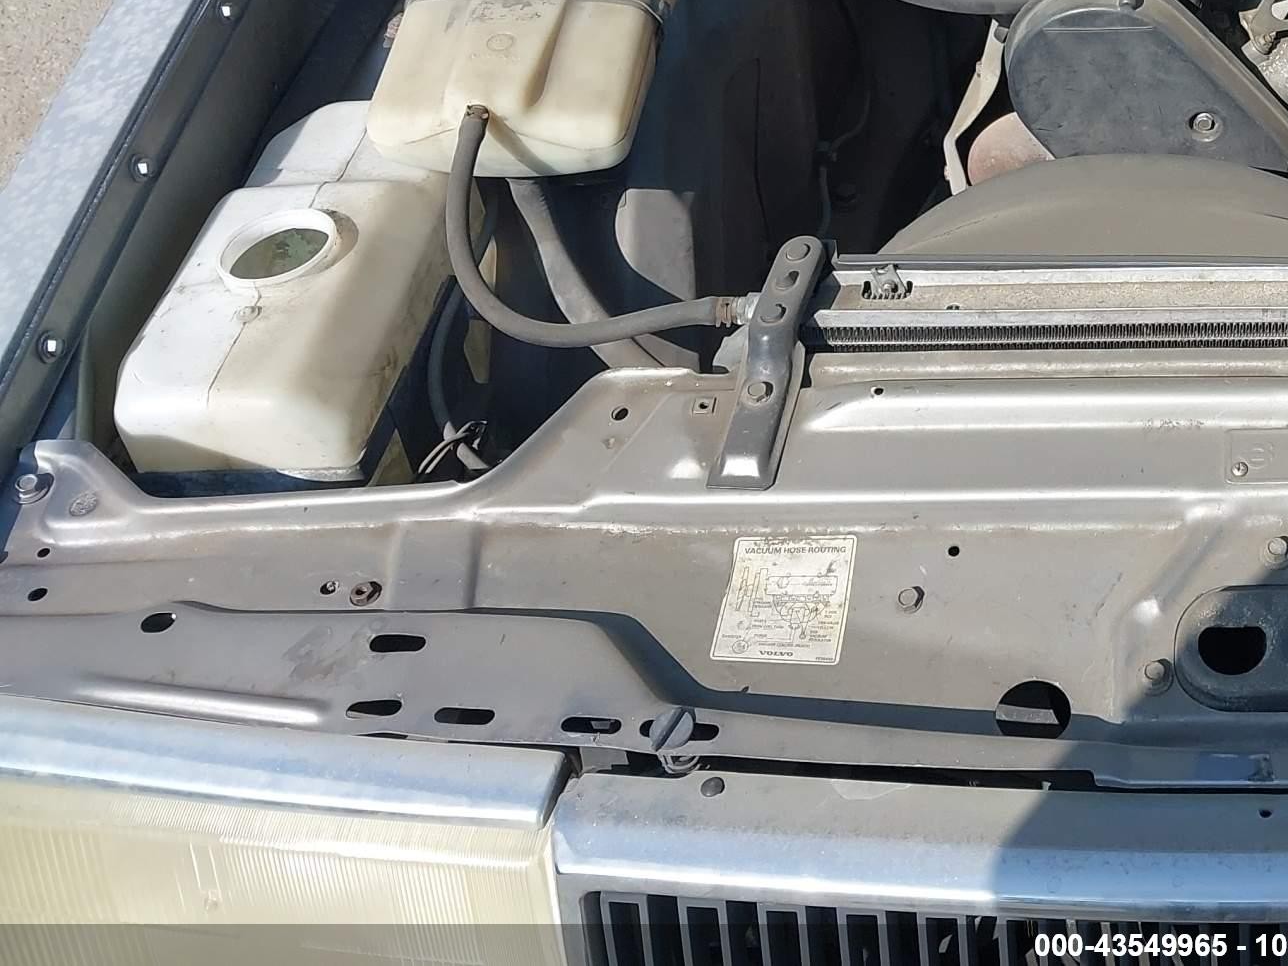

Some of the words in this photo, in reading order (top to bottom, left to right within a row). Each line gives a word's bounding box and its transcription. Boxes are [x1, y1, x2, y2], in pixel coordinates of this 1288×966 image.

[745, 546, 782, 555] VACUUM
[783, 546, 806, 554] HOSE
[808, 546, 847, 554] ROUTING
